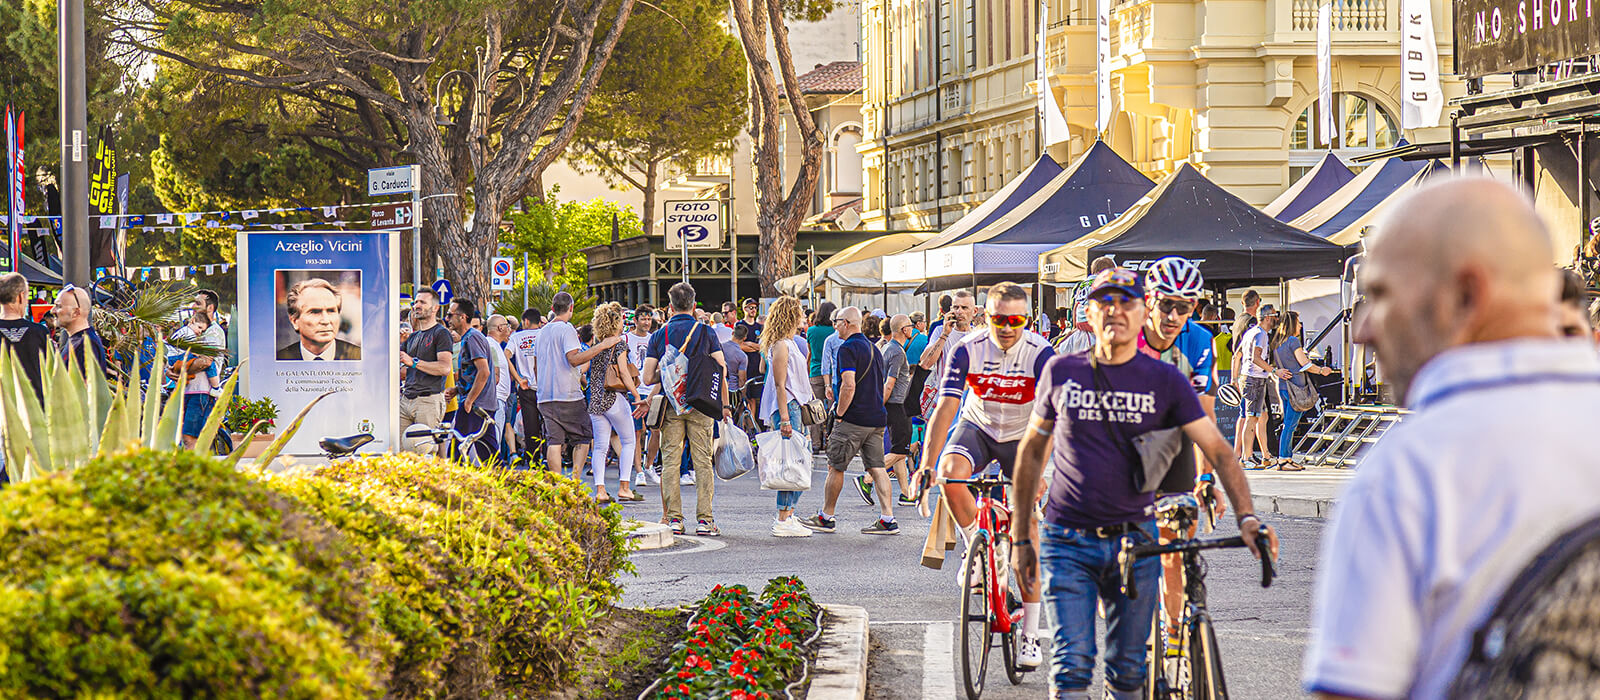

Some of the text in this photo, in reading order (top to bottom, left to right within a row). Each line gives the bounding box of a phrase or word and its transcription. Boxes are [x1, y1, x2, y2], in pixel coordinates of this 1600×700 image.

[1475, 6, 1502, 43] NO
[372, 178, 410, 191] G. Carducci
[674, 203, 710, 211] FOTO
[371, 218, 395, 227] di Levante
[667, 213, 718, 222] STUDIO
[685, 226, 702, 240] 3
[275, 240, 362, 255] Azeglio Vicini
[977, 376, 1026, 388] TREK
[1068, 389, 1156, 413] BOXEUR
[1078, 409, 1103, 421] DES
